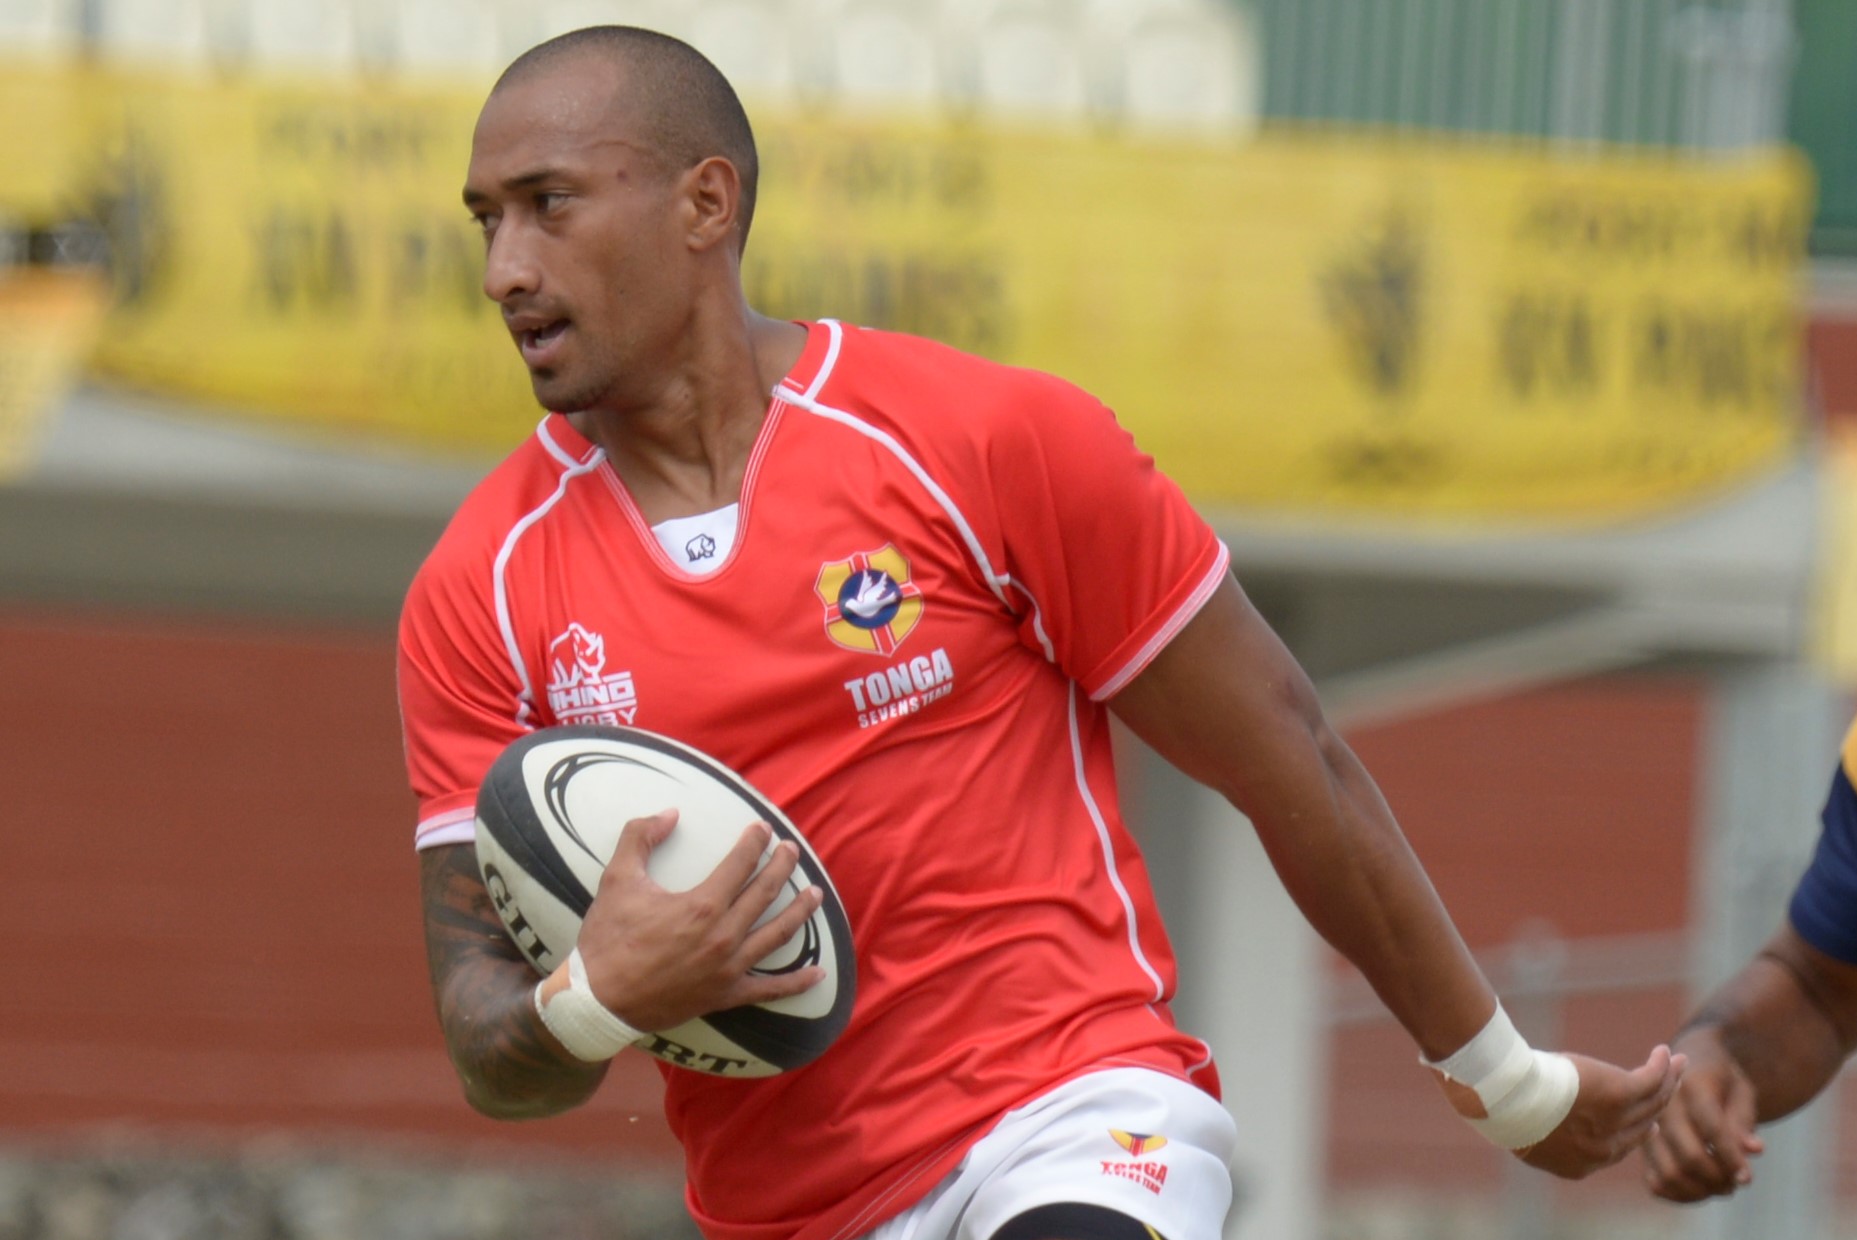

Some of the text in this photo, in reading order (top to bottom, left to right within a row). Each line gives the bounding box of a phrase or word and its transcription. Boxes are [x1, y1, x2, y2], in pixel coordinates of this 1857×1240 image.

[844, 647, 954, 712] TONGA
[858, 681, 953, 729] SEVENS TEAM
[1100, 1160, 1168, 1186] TONGA
